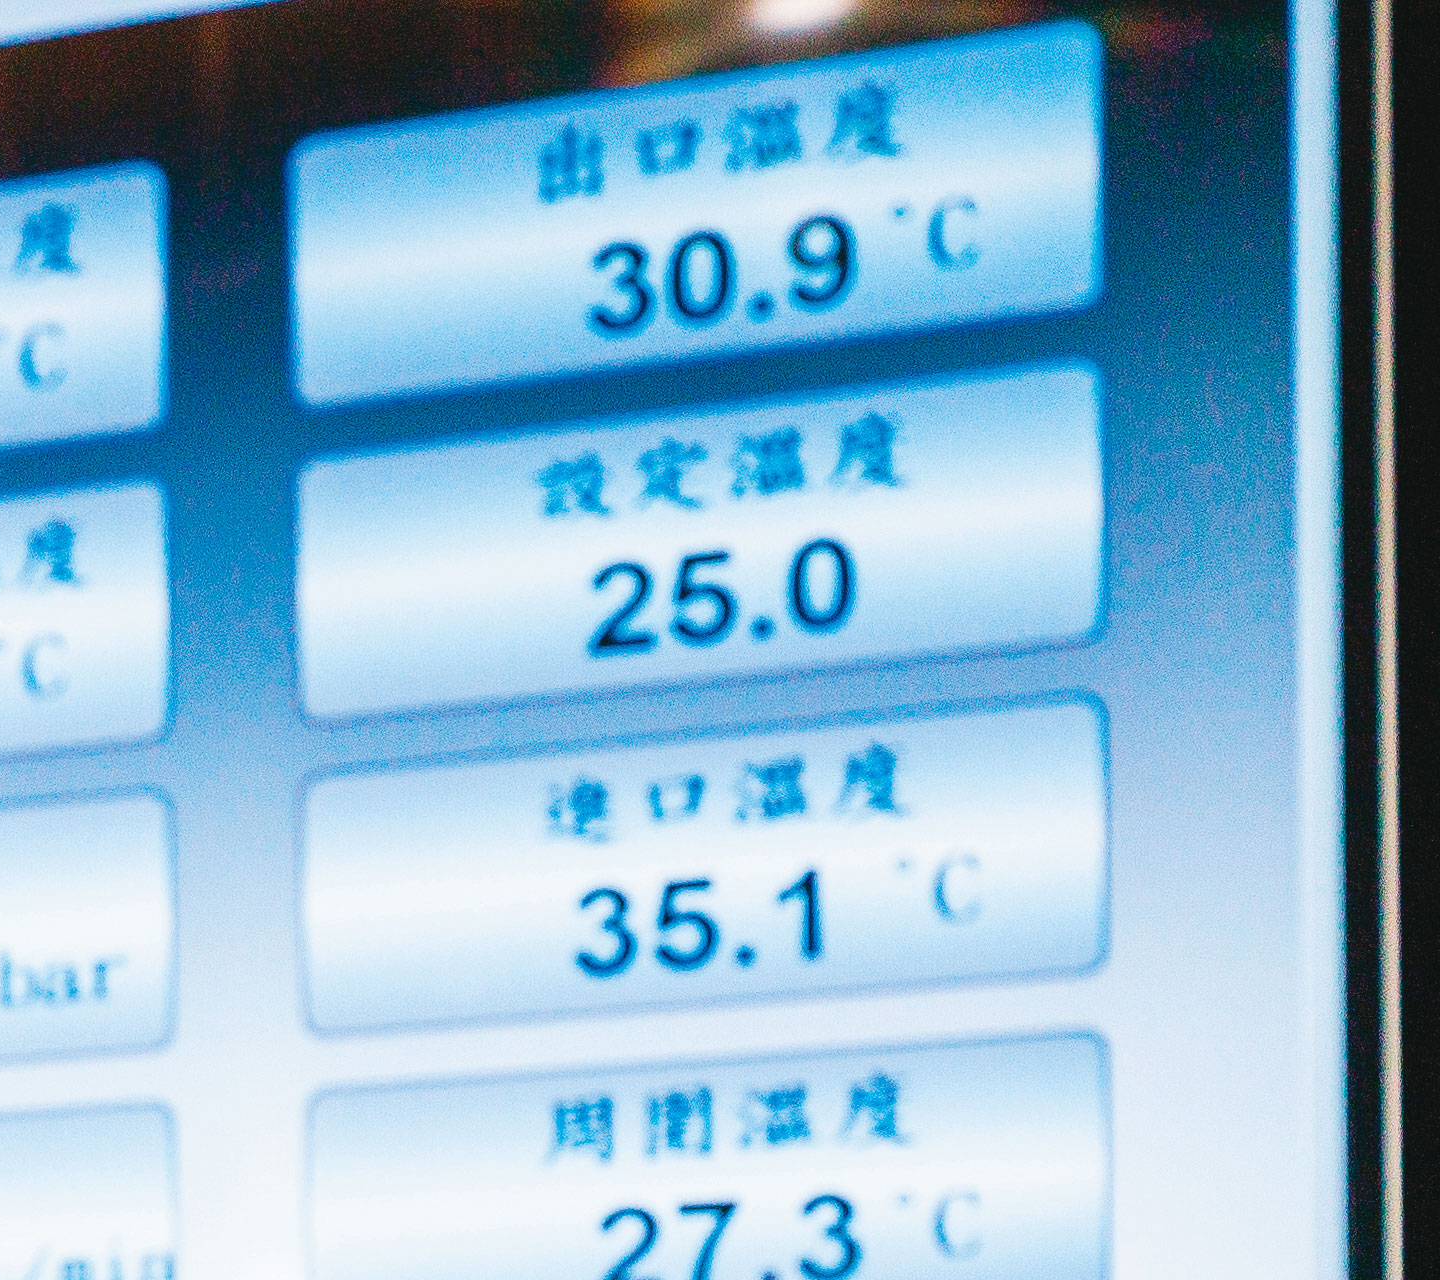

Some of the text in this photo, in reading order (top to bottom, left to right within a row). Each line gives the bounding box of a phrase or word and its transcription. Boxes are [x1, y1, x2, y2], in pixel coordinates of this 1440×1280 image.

[588, 213, 858, 340] 30.9
[534, 411, 904, 520] 設定溫度
[586, 537, 858, 658] 25.0
[574, 868, 826, 980] 35.1
